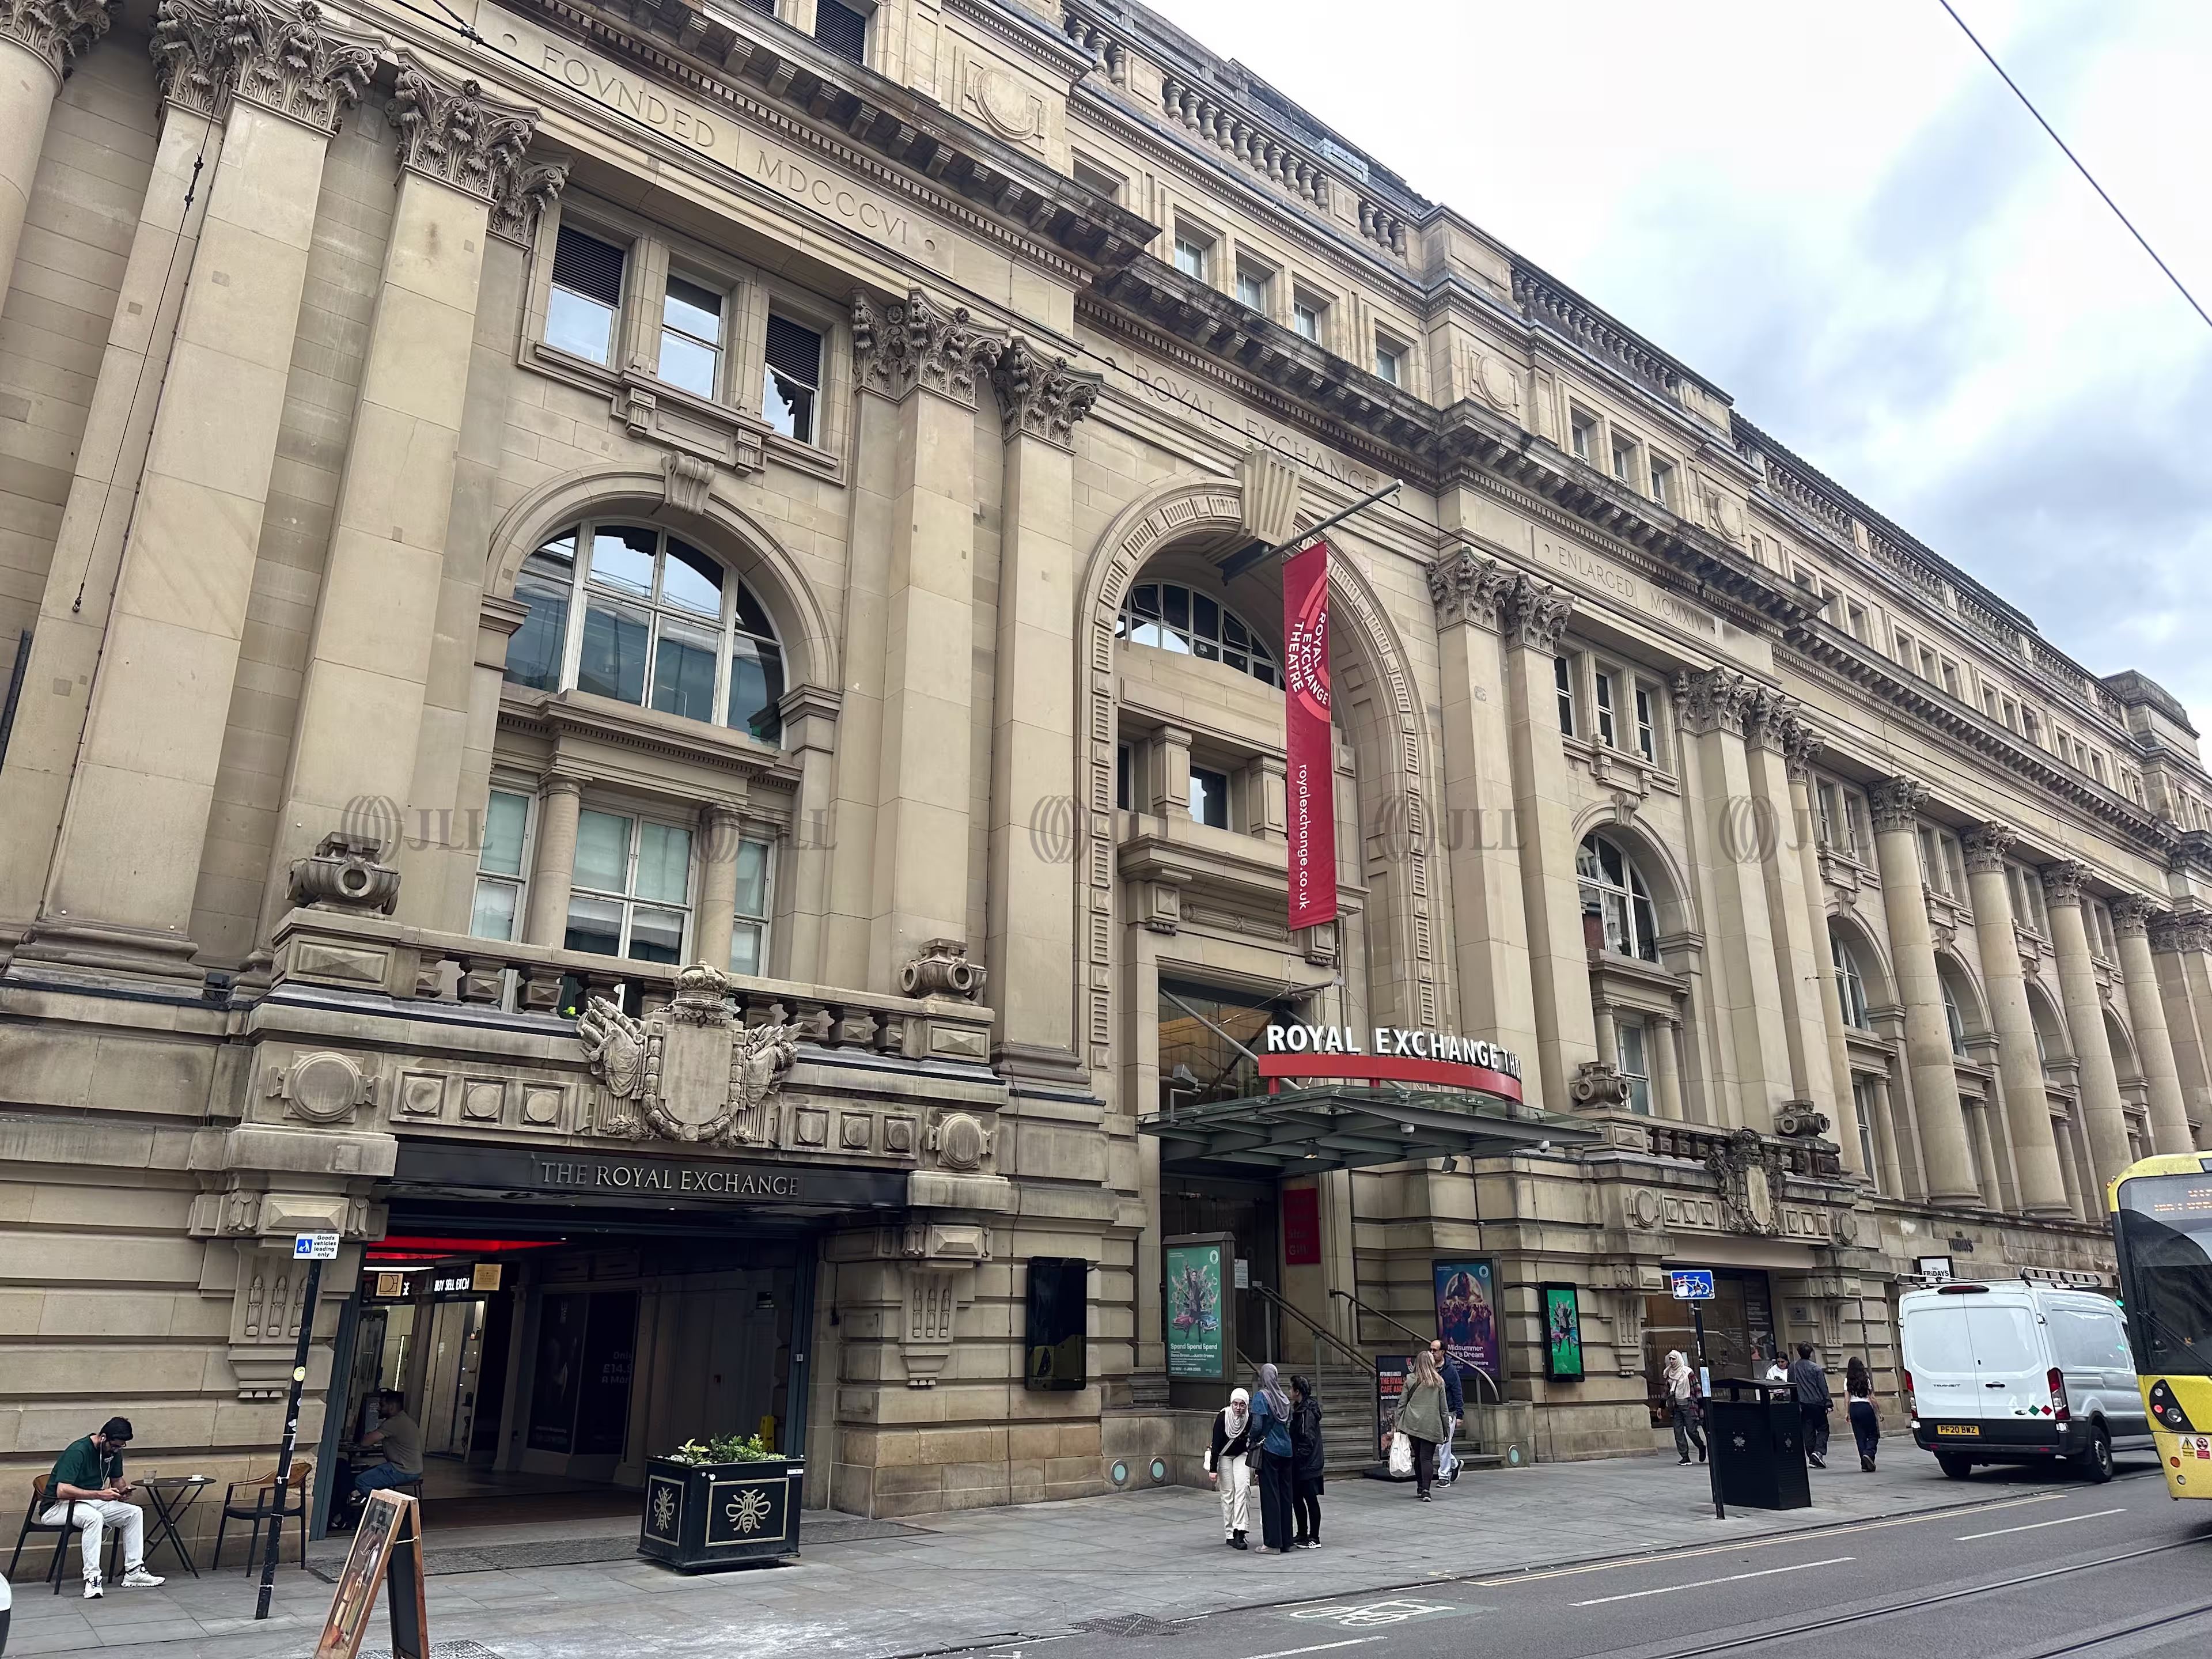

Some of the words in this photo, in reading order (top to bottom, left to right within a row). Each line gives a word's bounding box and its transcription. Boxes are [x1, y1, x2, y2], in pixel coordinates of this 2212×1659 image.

[756, 150, 908, 245] MDCCCVI
[1133, 364, 1223, 429] ROYAL
[1244, 418, 1378, 493] EXCHANGE
[1558, 546, 1634, 599] ENLARGED
[1650, 592, 1703, 632] MCMXIV
[1288, 621, 1305, 692] THEATRE
[1301, 633, 1328, 706] EXCHANGE
[1313, 612, 1327, 668] ROYAL
[1296, 764, 1311, 910] royalexchange.co.uk
[1267, 1025, 1361, 1053] ROYAL
[1375, 1027, 1498, 1070] EXCHANGE
[541, 1162, 587, 1185] THE
[595, 1166, 672, 1190] ROYAL
[680, 1170, 800, 1196] EXCHANGE
[434, 1279, 445, 1291] BUY
[445, 1278, 454, 1291] SELL
[1941, 1426, 1959, 1434] PF20
